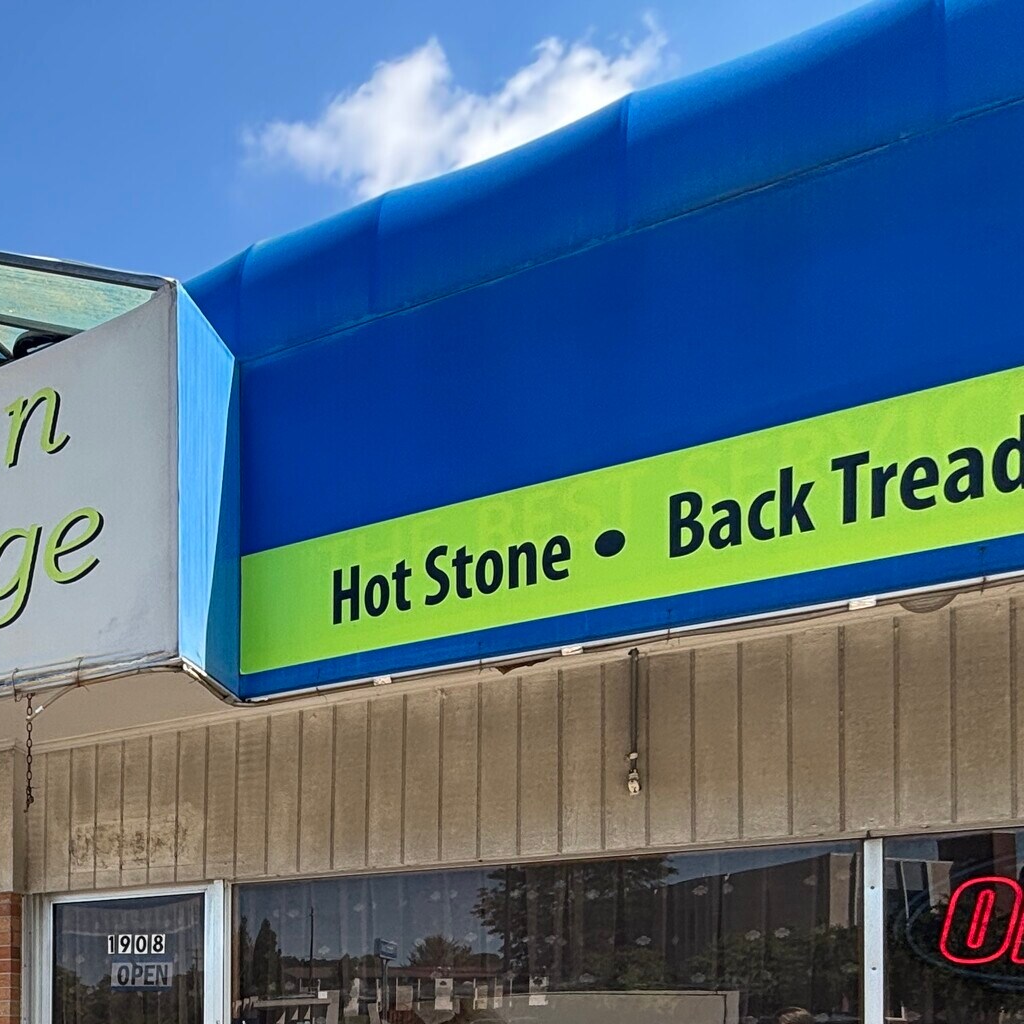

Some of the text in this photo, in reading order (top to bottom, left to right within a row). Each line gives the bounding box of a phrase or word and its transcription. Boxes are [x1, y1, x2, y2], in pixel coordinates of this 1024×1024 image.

[332, 414, 1024, 625] Hot Stone Back Tread
[108, 934, 164, 953] 1908
[117, 964, 168, 986] OPEN
